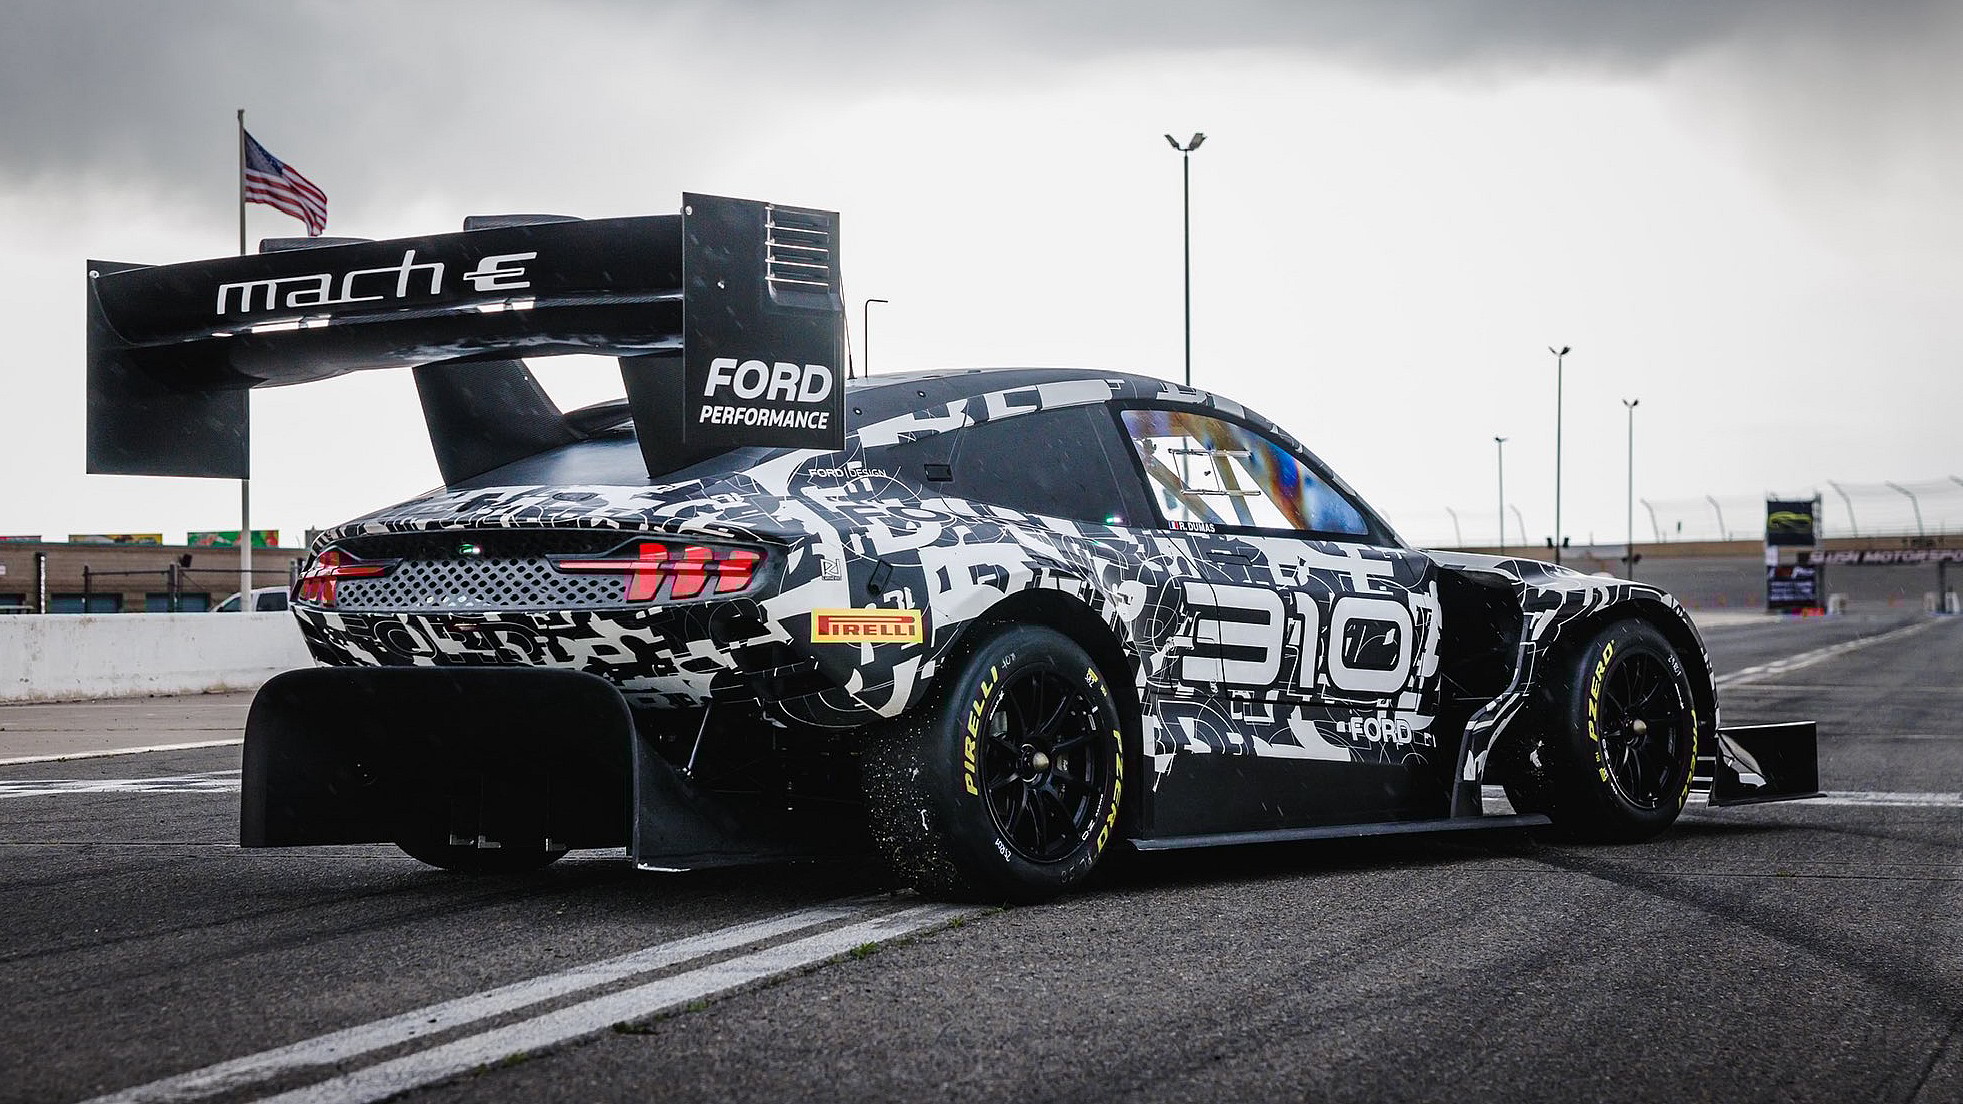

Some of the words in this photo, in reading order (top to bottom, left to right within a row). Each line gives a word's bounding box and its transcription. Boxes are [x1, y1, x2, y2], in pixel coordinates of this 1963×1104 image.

[216, 249, 445, 316] mach
[703, 357, 833, 403] FORD
[698, 405, 831, 431] PERFORMANCE
[1188, 522, 1216, 533] DUMAS
[817, 614, 916, 637] PIRELLI
[1181, 582, 1414, 694] 310
[963, 665, 1000, 797] PIRELLI
[1351, 716, 1413, 745] FORD
